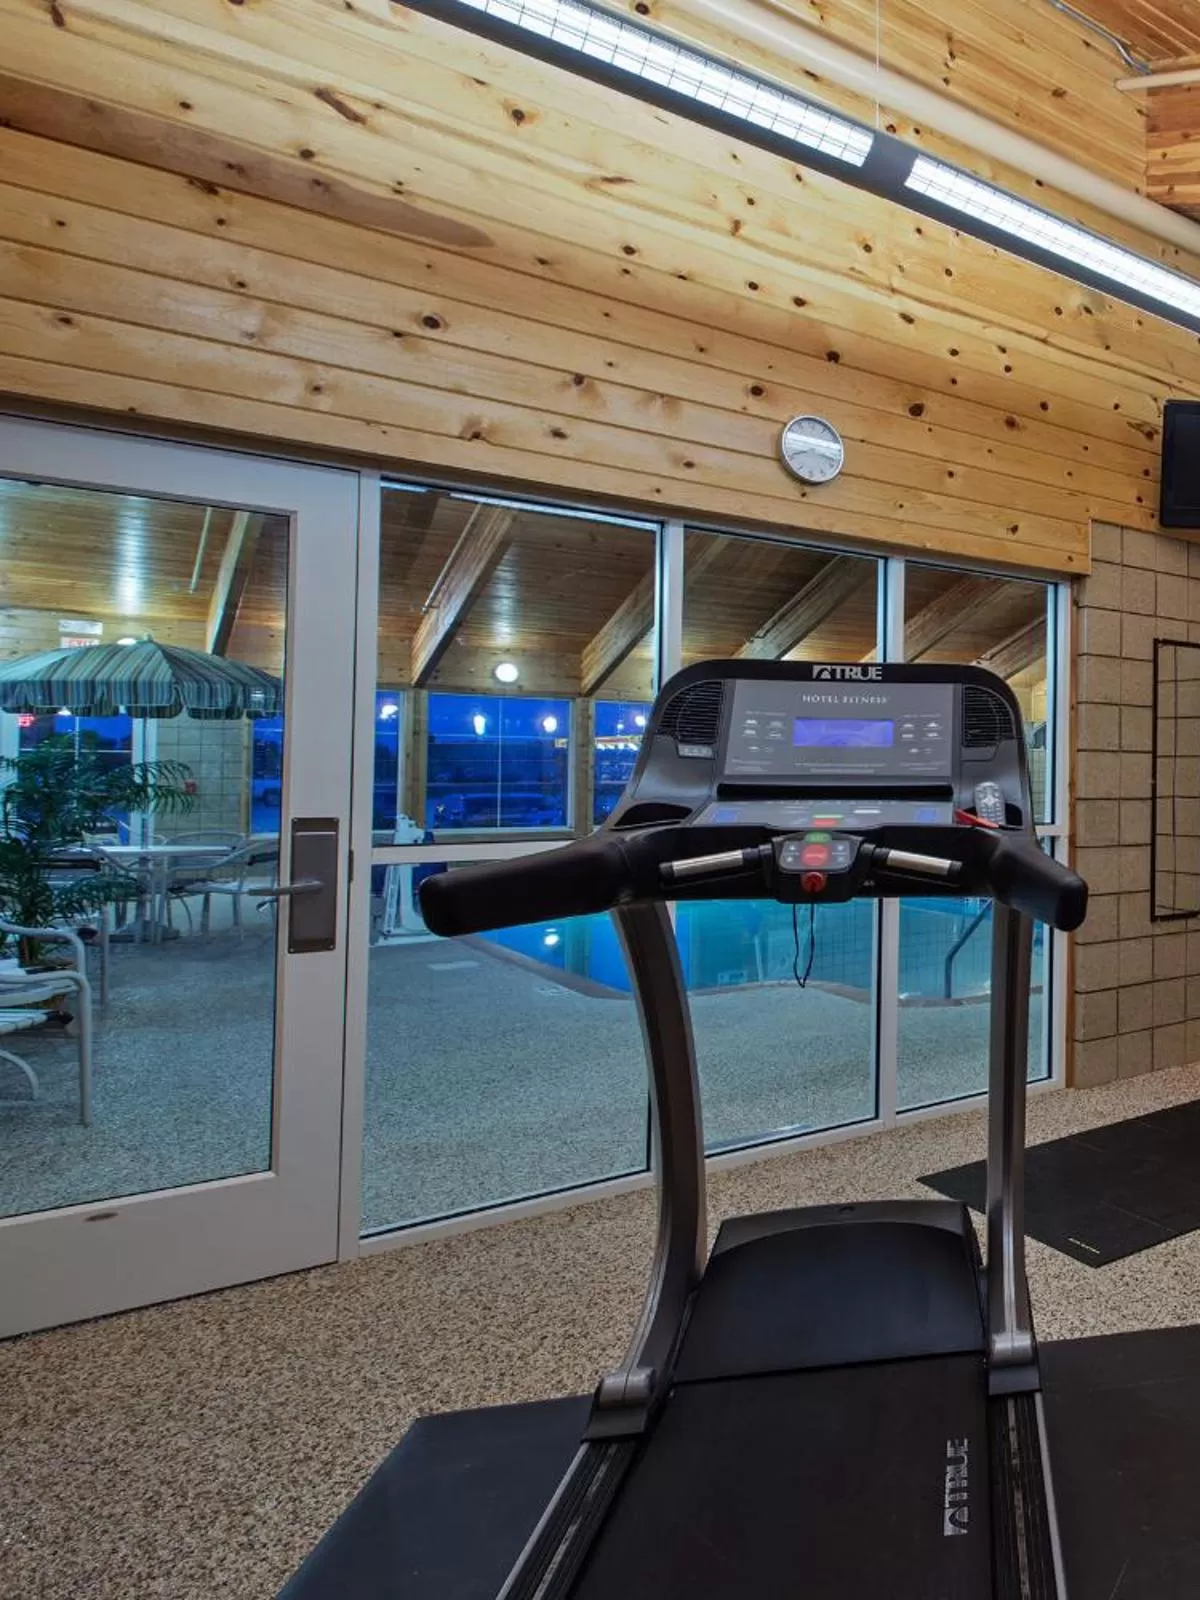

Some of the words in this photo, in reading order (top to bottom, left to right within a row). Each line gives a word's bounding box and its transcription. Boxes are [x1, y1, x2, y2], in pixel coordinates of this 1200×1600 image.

[831, 665, 882, 680] TRUE
[802, 693, 839, 704] HOTEL
[945, 1438, 969, 1508] TRUE
